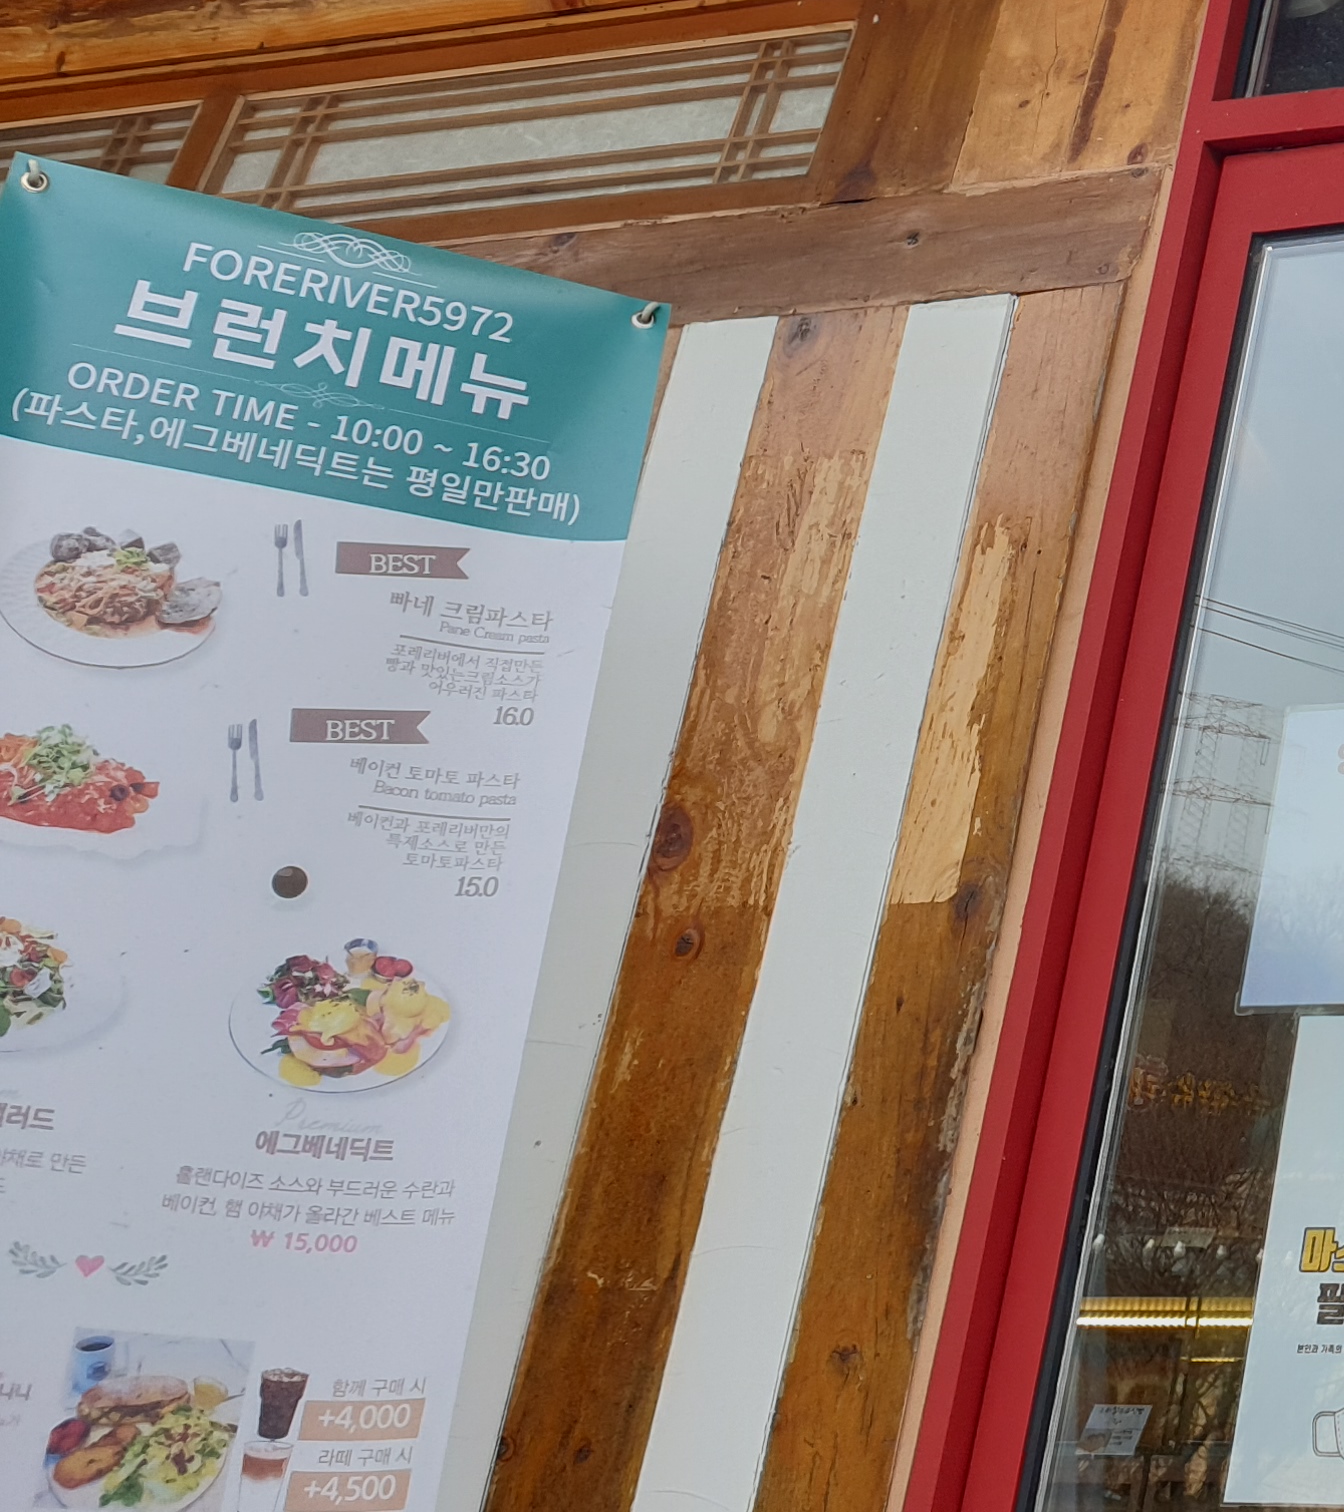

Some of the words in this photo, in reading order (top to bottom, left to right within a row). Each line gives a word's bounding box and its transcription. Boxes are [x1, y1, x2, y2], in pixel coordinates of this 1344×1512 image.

[182, 241, 514, 343] FORERIVER5972
[113, 279, 529, 420] 브런치메뉴
[67, 361, 200, 411] ORDER
[212, 388, 299, 430] TIME
[330, 415, 423, 455] 10:00
[462, 442, 550, 481] 16:30
[11, 387, 395, 490] (파스타,에그베네딕트는
[406, 465, 581, 526] 평일만판매)
[369, 552, 436, 576] BEST
[390, 591, 435, 618] 빠네
[440, 601, 553, 632] 크림파스타
[517, 632, 550, 645] pasta
[390, 643, 480, 670] 포레리버에서
[429, 680, 487, 701] 어우러진
[492, 687, 539, 704] 파스타
[493, 704, 535, 727] 16.0
[325, 718, 395, 742] BEST
[350, 757, 402, 780] 베이컨
[405, 765, 460, 786] 토마토
[466, 771, 521, 790] 파스타
[373, 779, 419, 800] Bacon
[424, 792, 475, 805] tomato
[479, 793, 517, 808] pasta
[347, 810, 410, 834] 베이컨과
[414, 820, 511, 840] 포레리버만의
[474, 840, 507, 856] 만든
[402, 852, 504, 872] 토마토파스타
[454, 875, 500, 898] 15.0
[275, 1097, 383, 1134] Premium
[255, 1129, 395, 1163] 에그베네딕트
[50, 1153, 87, 1175] 만든
[268, 1175, 323, 1196] 소스와
[327, 1178, 399, 1200] 부드러운
[225, 1199, 244, 1220] 햄
[248, 1201, 302, 1224] 야채가
[305, 1205, 359, 1227] 올라간
[363, 1208, 416, 1226] 베스트
[421, 1208, 456, 1226] 메뉴
[284, 1231, 359, 1255] 15,000
[332, 1378, 368, 1399] 함께
[371, 1377, 406, 1398] 구매
[409, 1376, 427, 1396] 시
[318, 1402, 412, 1435] +4,000
[318, 1448, 353, 1467] 라떼
[357, 1446, 392, 1467] 구매
[395, 1445, 414, 1465] 시
[303, 1473, 397, 1507] +4,500
